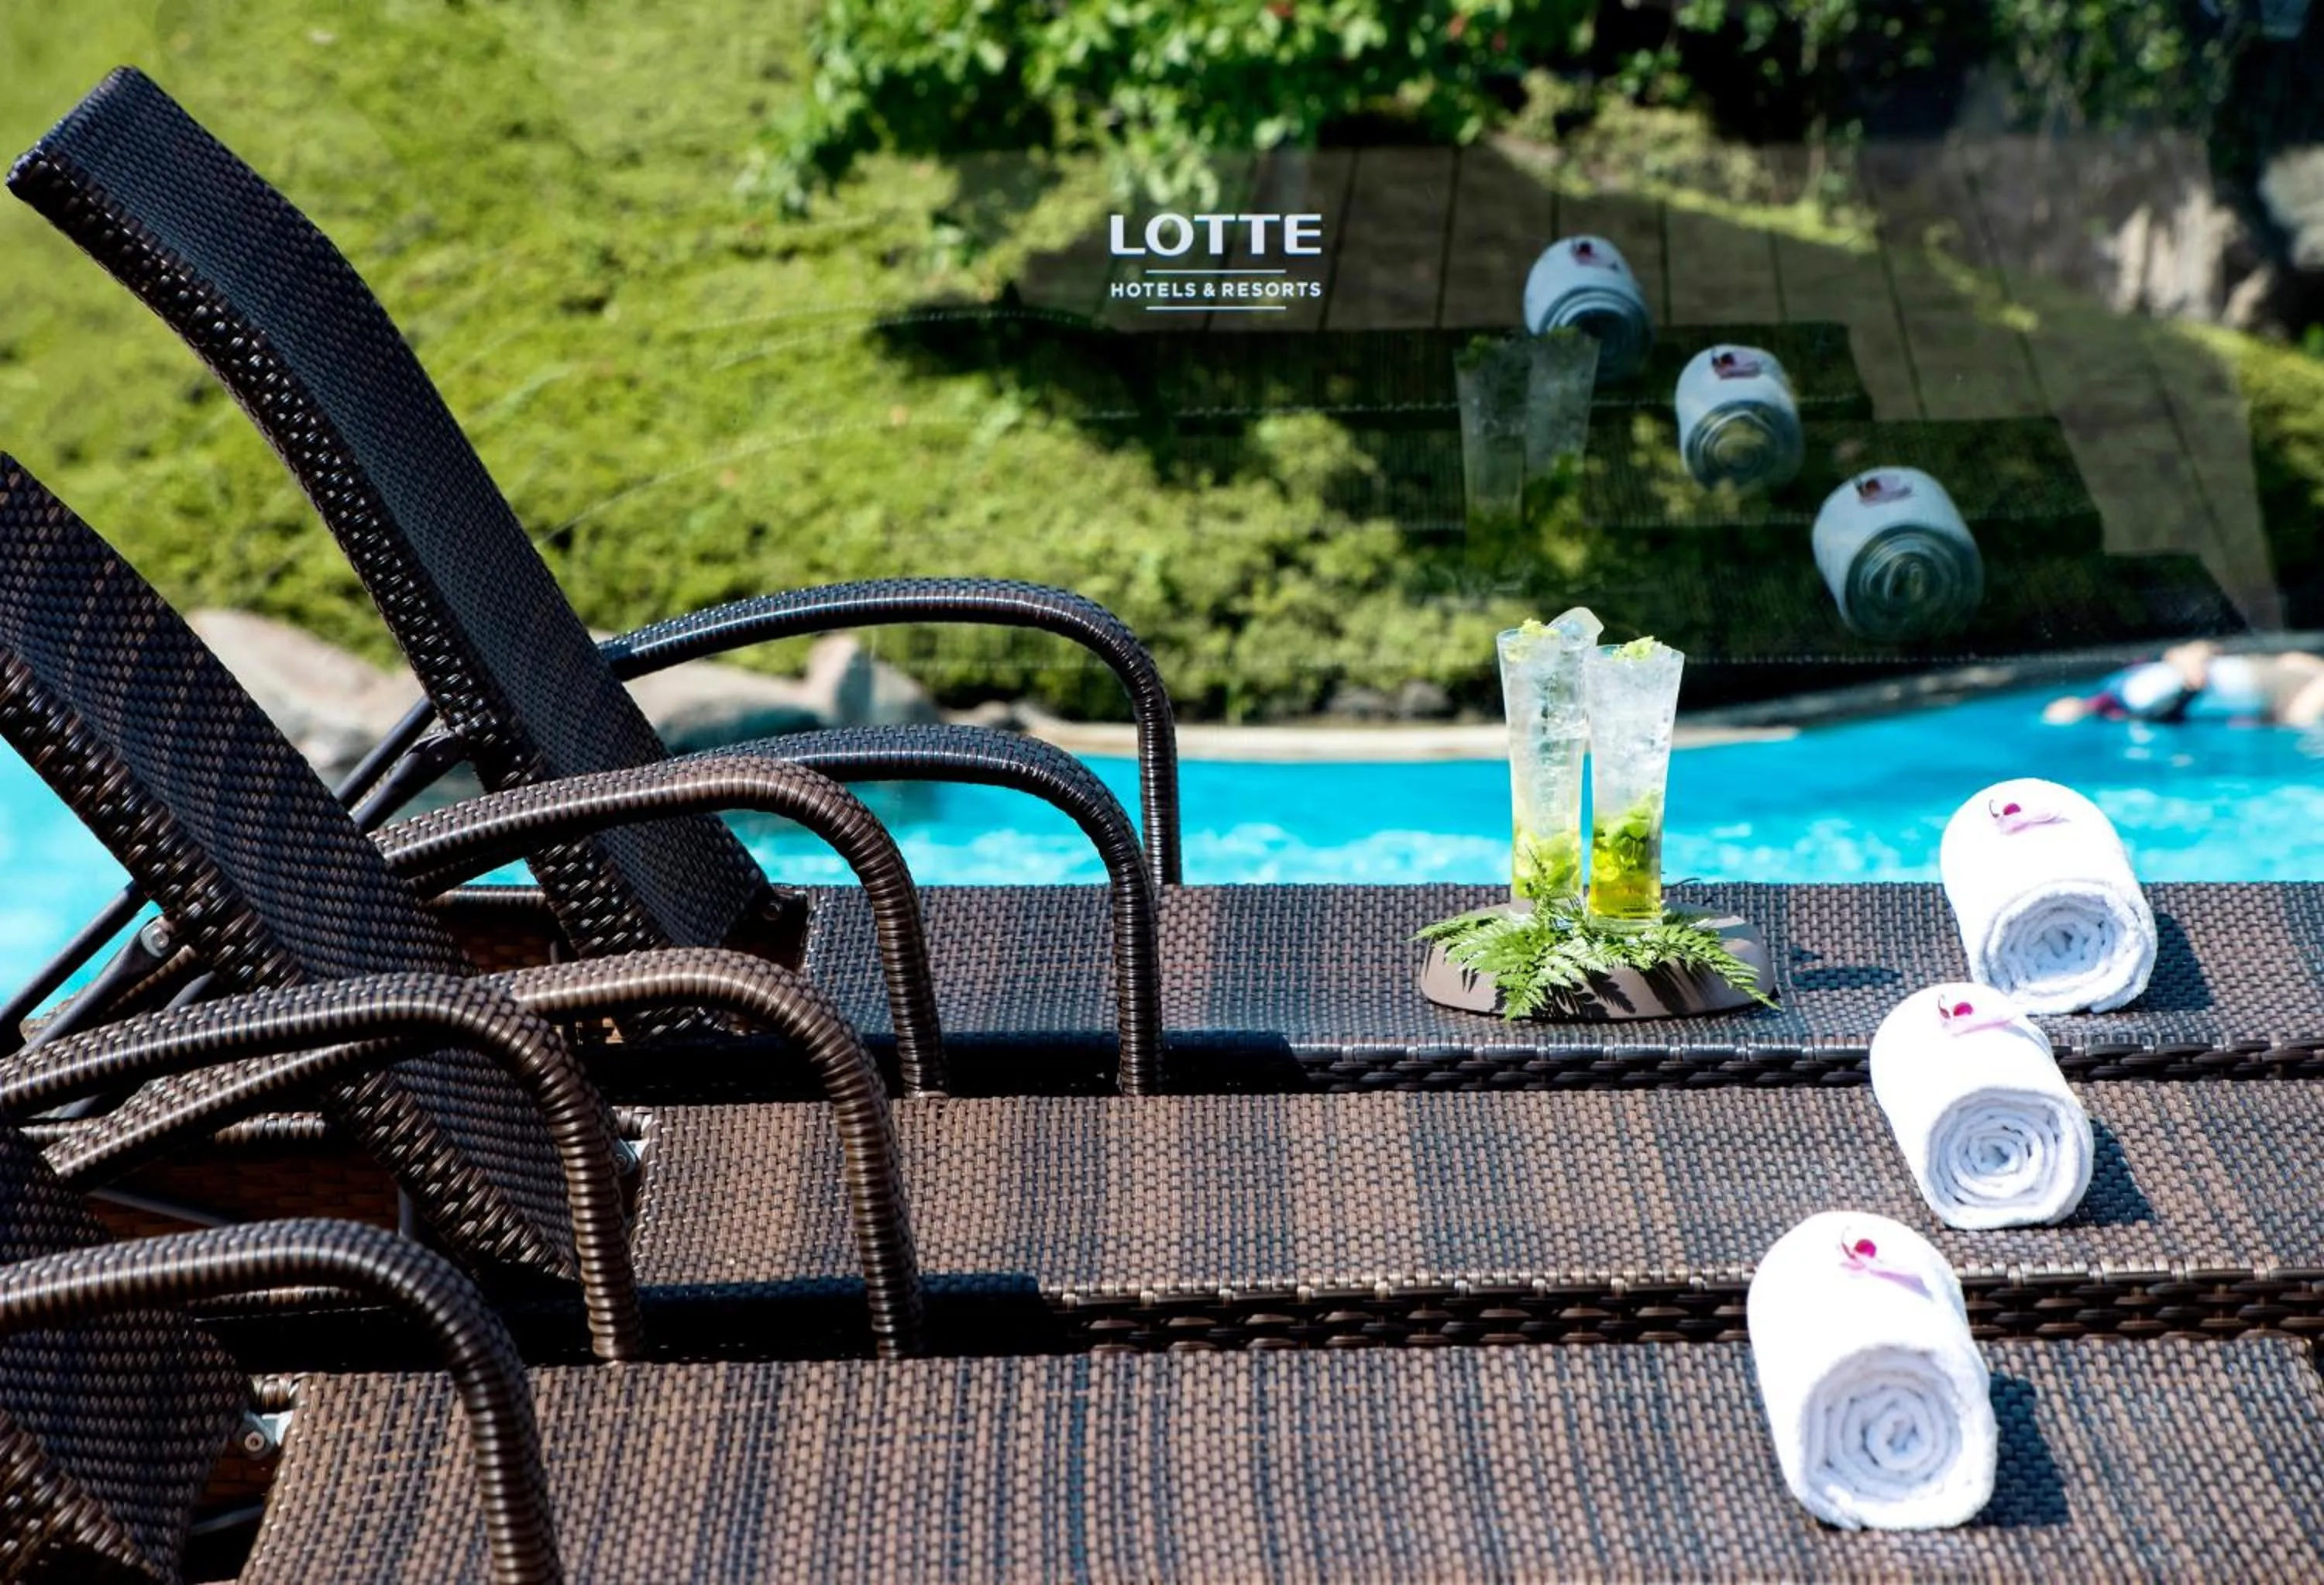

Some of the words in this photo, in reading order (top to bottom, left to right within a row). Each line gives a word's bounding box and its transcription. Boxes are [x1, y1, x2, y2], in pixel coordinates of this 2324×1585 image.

[1110, 213, 1322, 256] LOTTE
[1110, 282, 1196, 297] HOTELS
[1203, 282, 1215, 297] &
[1222, 282, 1322, 297] RESORTS
